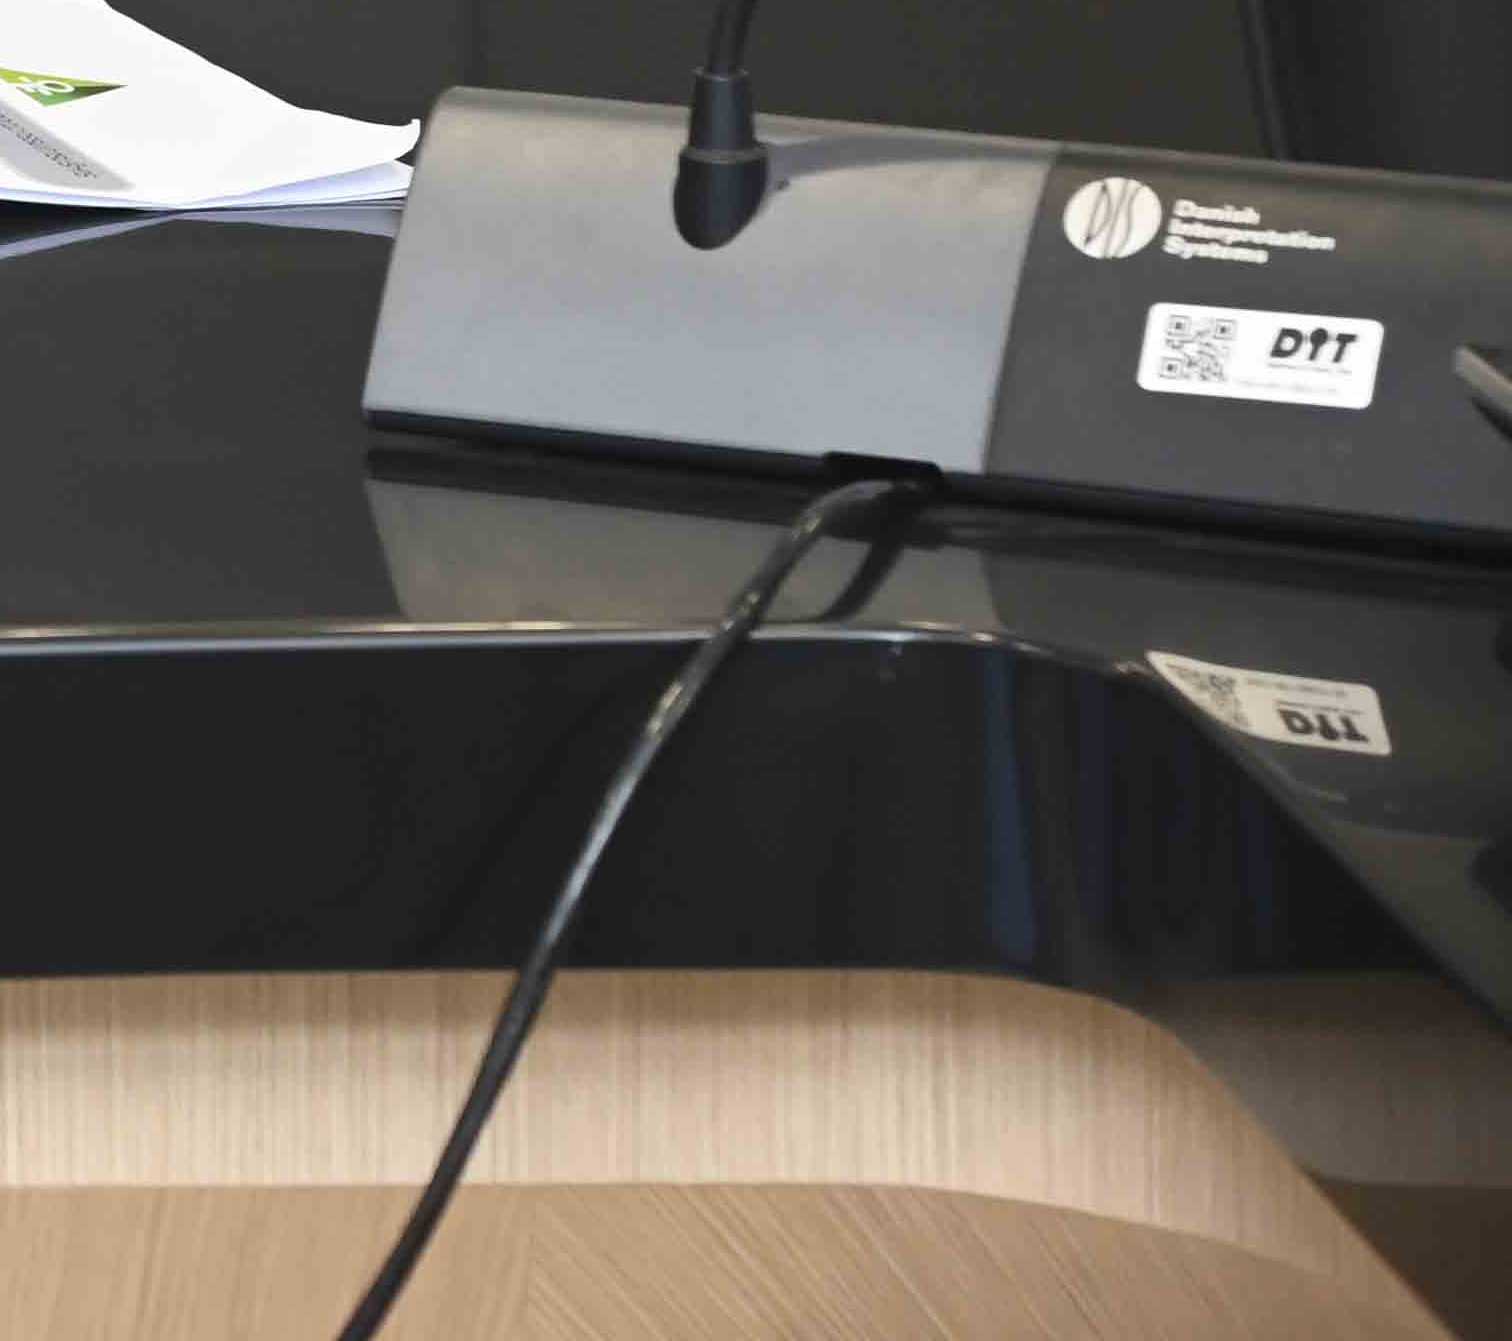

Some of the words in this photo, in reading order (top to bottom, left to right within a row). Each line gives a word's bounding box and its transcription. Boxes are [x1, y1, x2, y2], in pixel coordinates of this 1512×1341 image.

[1173, 199, 1260, 225] Danish
[1168, 217, 1336, 250] Interpretation
[1163, 234, 1268, 263] Systems
